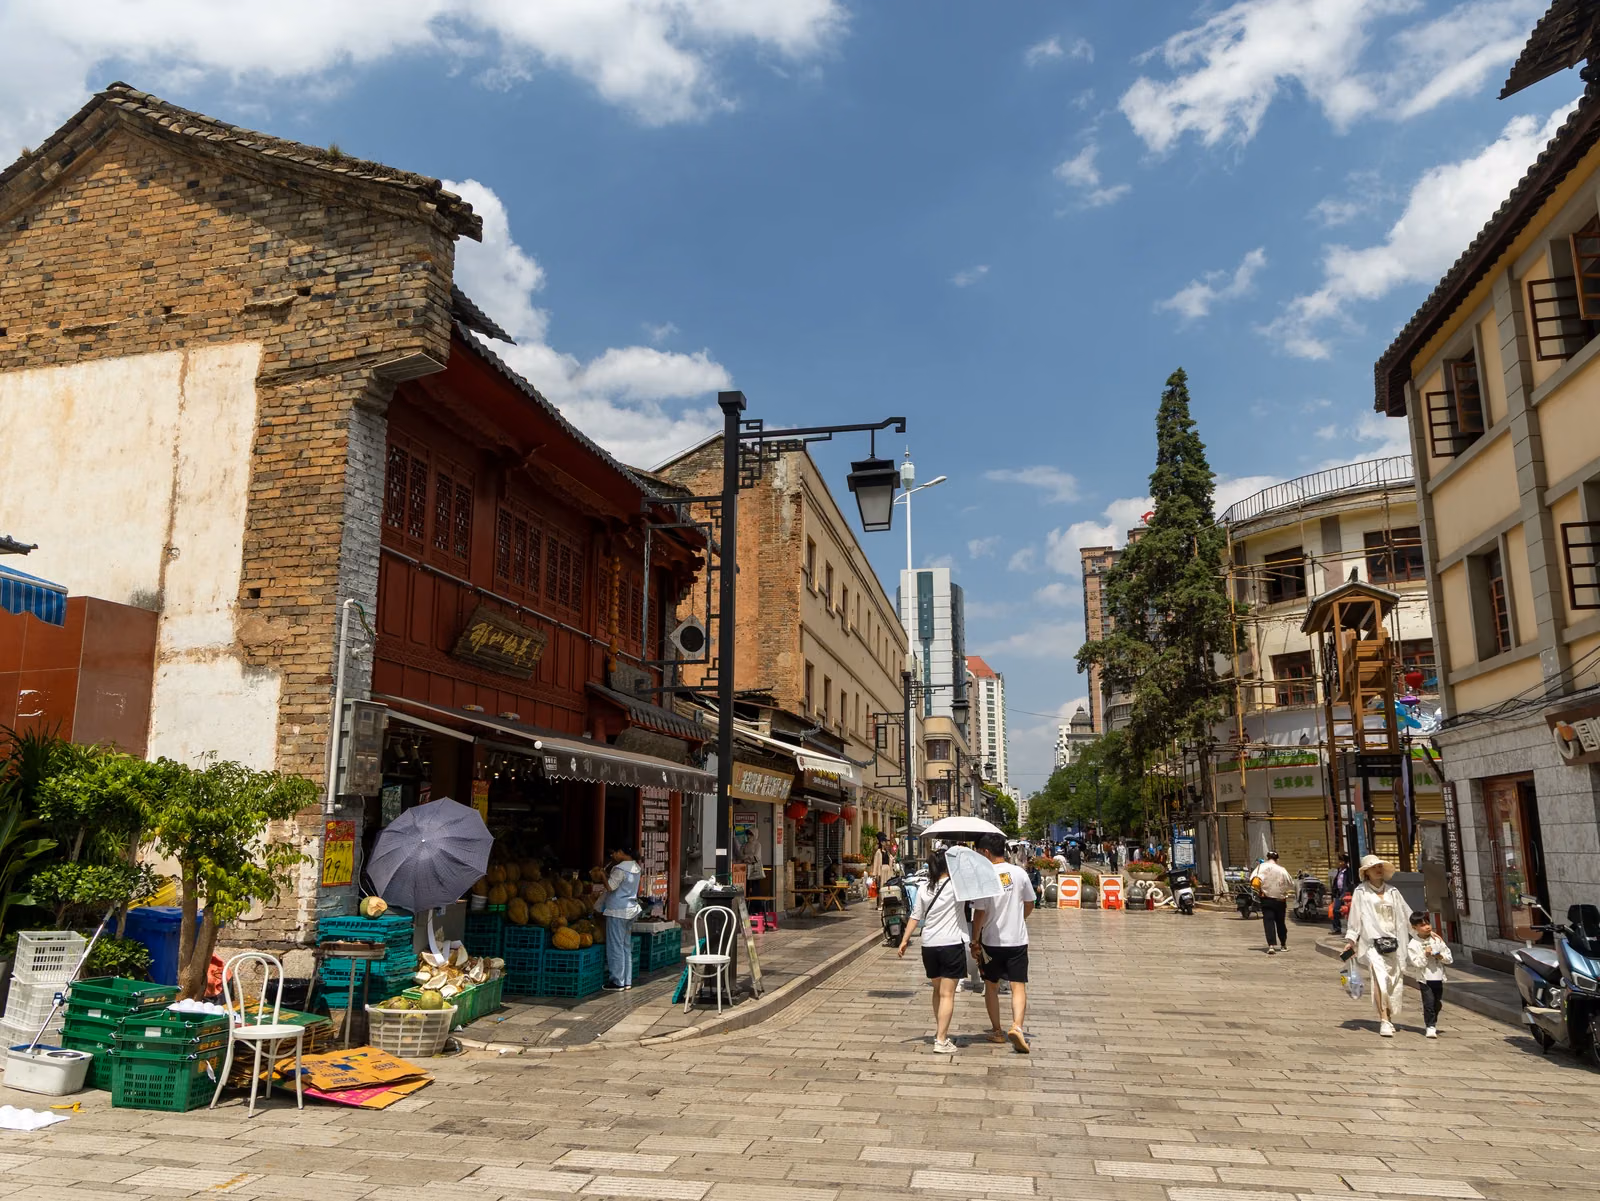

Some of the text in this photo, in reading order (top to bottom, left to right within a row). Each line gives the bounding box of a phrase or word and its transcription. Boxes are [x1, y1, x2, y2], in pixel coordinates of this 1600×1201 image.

[1449, 831, 1465, 910] 五华光华街诊所
